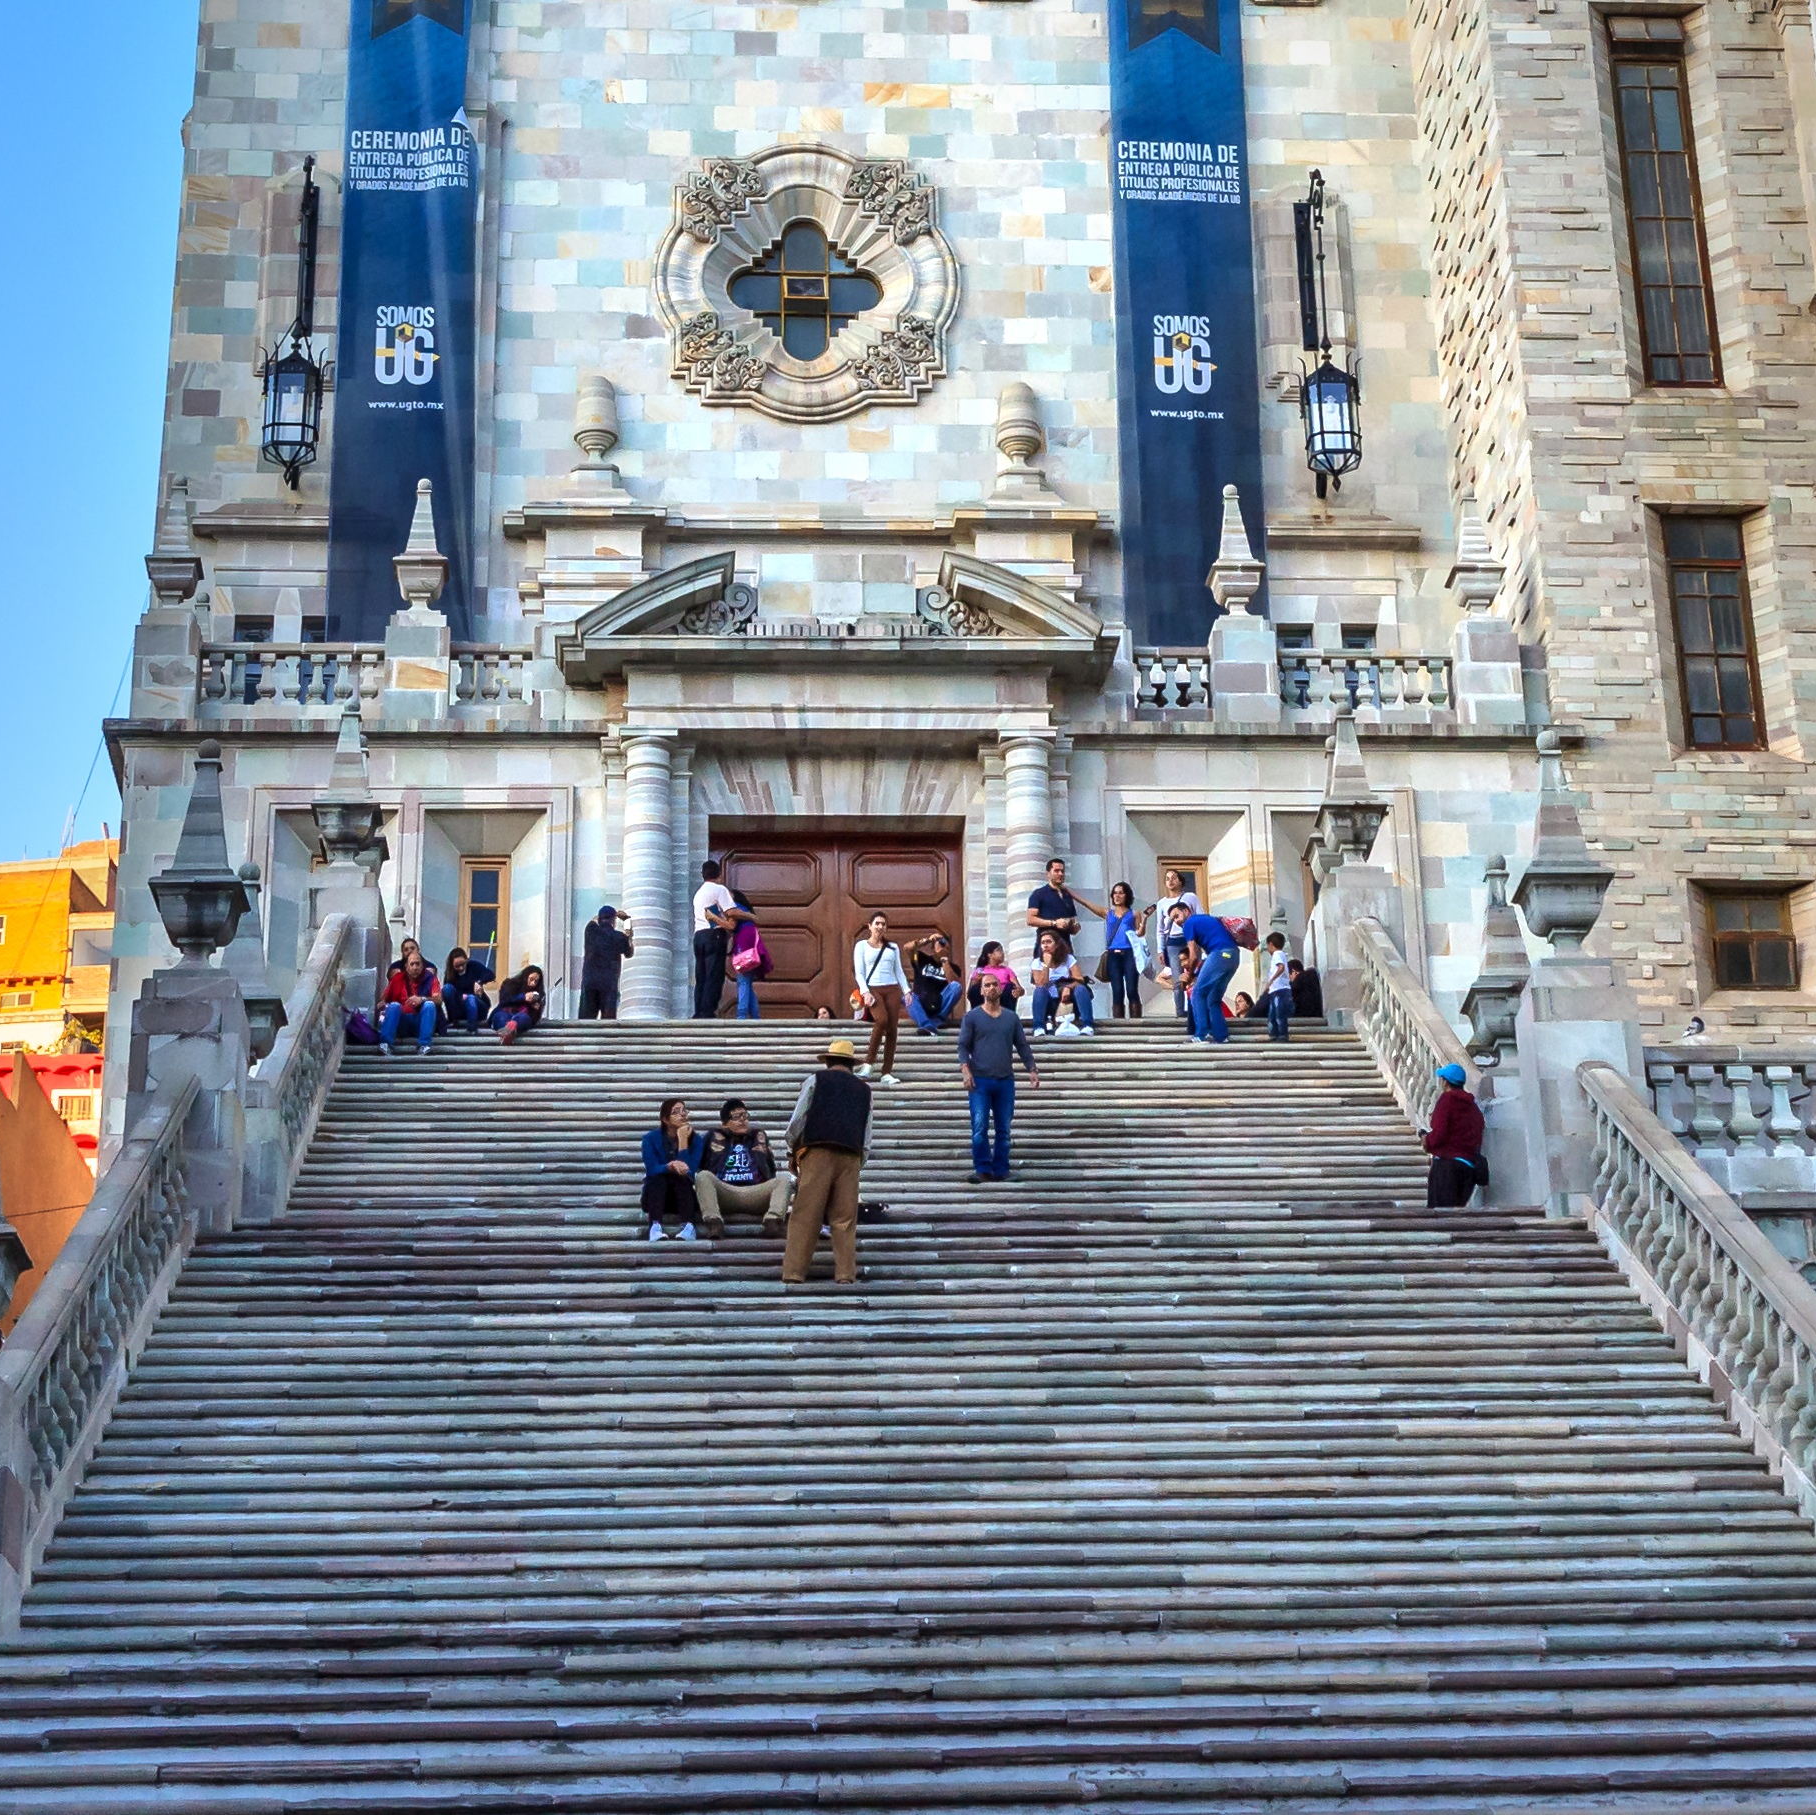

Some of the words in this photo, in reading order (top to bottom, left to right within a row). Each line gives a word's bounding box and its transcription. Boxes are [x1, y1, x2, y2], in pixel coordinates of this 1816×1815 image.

[350, 127, 446, 151] CEREMONIA
[450, 127, 470, 148] DE
[349, 151, 404, 166] ENTREGA
[406, 148, 454, 167] PÚBLICA
[456, 148, 469, 164] DE
[1117, 140, 1213, 163] CEREMONIA
[1217, 144, 1239, 164] DE
[349, 164, 391, 180] TÍTULOS
[393, 163, 469, 181] PROFESIONALES
[1117, 161, 1171, 176] ENTREGA
[1173, 160, 1222, 179] PÚBLICA
[1224, 165, 1240, 180] DE
[349, 180, 356, 190] Y
[355, 180, 388, 191] GRADOS
[436, 177, 448, 187] DE
[448, 176, 459, 187] LA
[1118, 174, 1160, 190] TÍTULOS
[1161, 177, 1240, 194] PROFESIONALES
[1119, 190, 1126, 200] Y
[1126, 190, 1157, 201] GRADOS
[1158, 190, 1207, 202] ACADÉMICOS
[1207, 193, 1218, 203] DE
[1219, 193, 1230, 204] LA
[1230, 194, 1241, 204] UG
[376, 305, 435, 328] SOMOS
[1153, 314, 1211, 338] SOMOS
[374, 327, 435, 386] UG
[1153, 336, 1212, 395] UG
[367, 400, 445, 412] www.ugto.mx
[1149, 409, 1225, 421] www.ugto.mx
